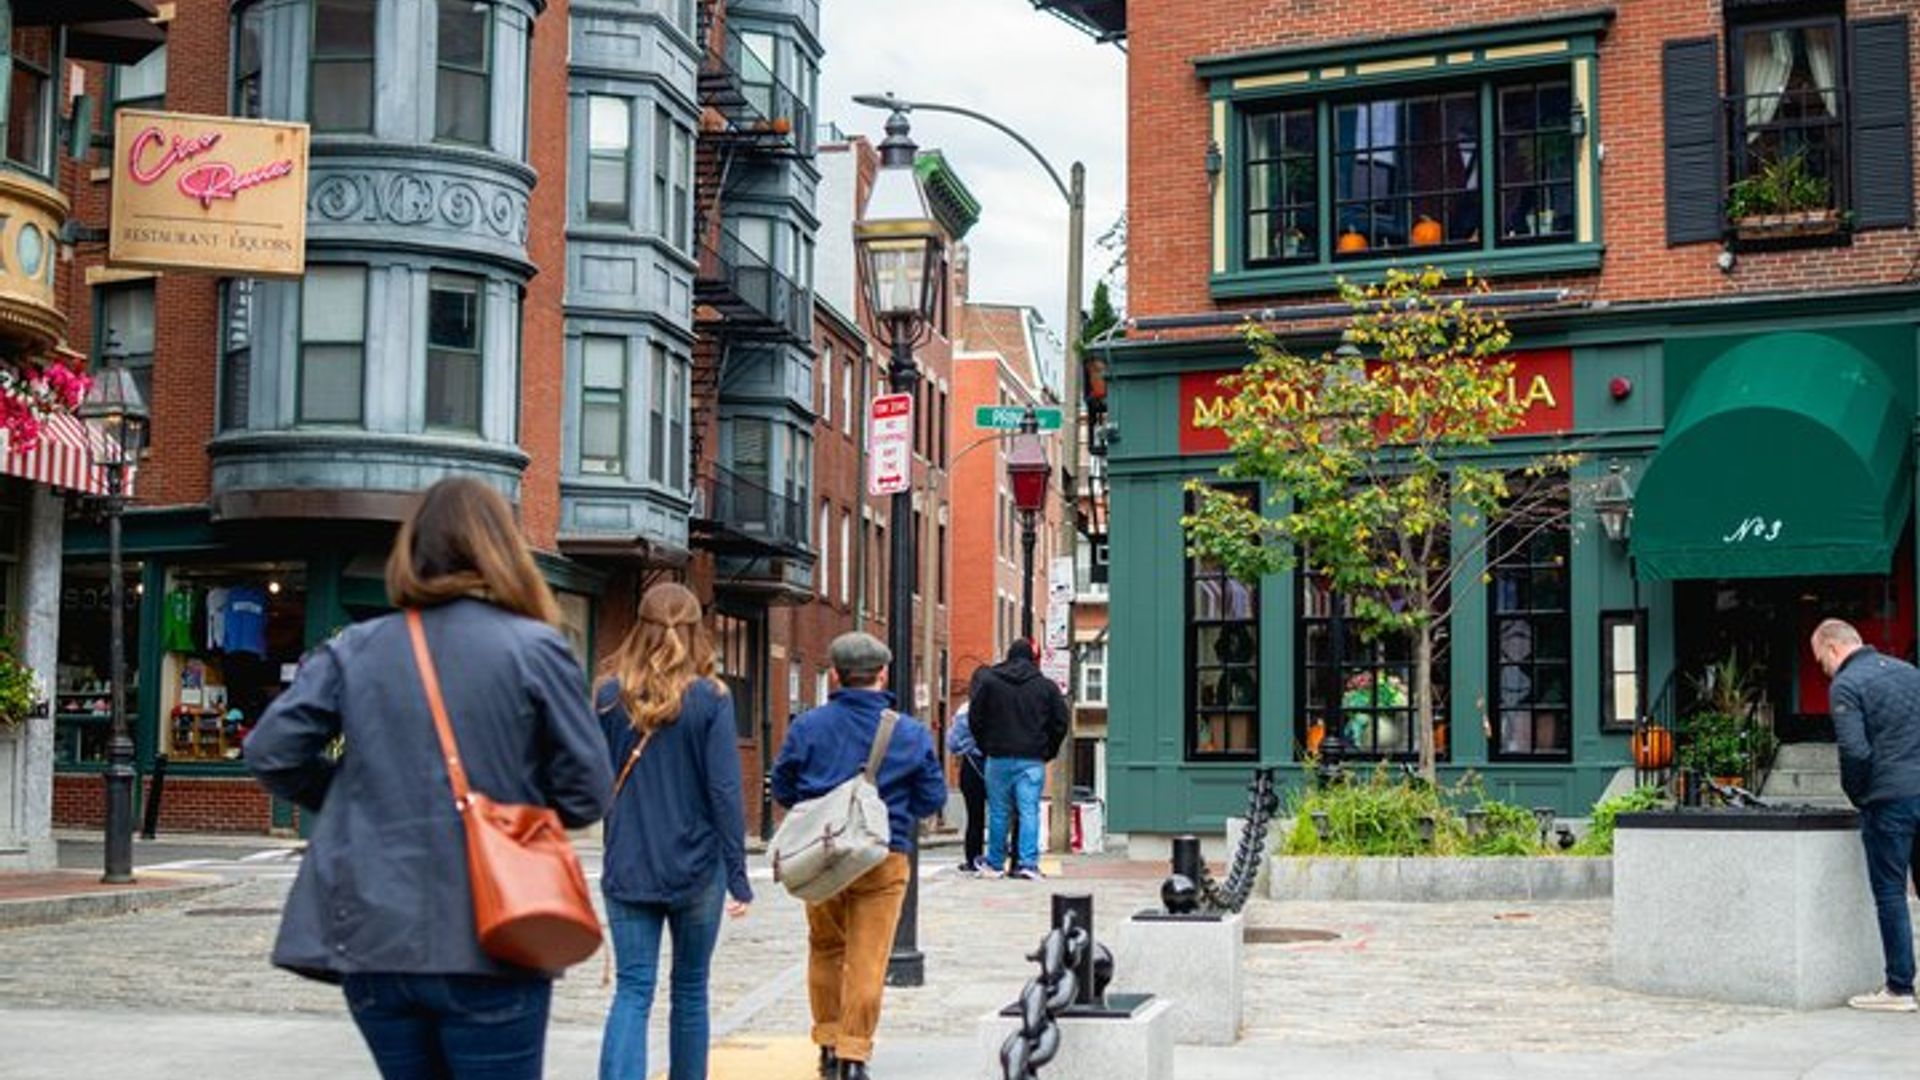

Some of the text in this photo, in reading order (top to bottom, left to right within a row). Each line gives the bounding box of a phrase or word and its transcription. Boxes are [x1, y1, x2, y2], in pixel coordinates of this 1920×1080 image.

[124, 228, 218, 247] RESTAURANT
[1393, 374, 1556, 416] MIA
[992, 408, 1025, 428] PRIN
